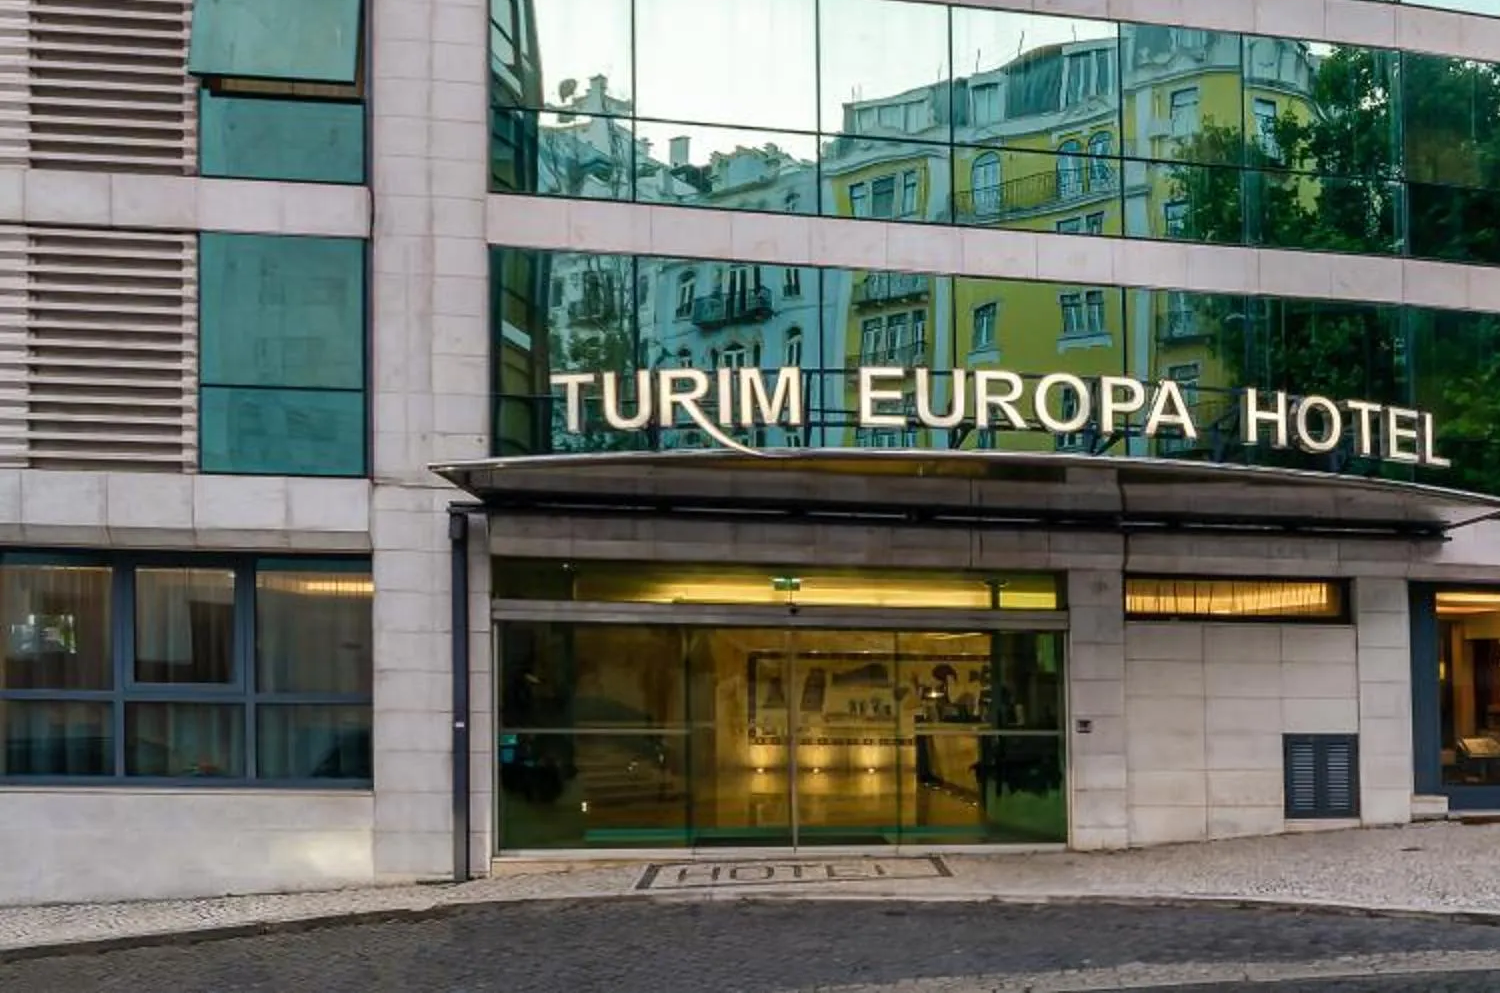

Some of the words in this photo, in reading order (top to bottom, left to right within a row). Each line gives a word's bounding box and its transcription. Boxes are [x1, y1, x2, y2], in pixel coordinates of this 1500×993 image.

[549, 366, 800, 457] TURIM
[859, 367, 1197, 438] EUROPA
[1242, 388, 1451, 467] HOTEL
[677, 862, 906, 883] HOTEL
